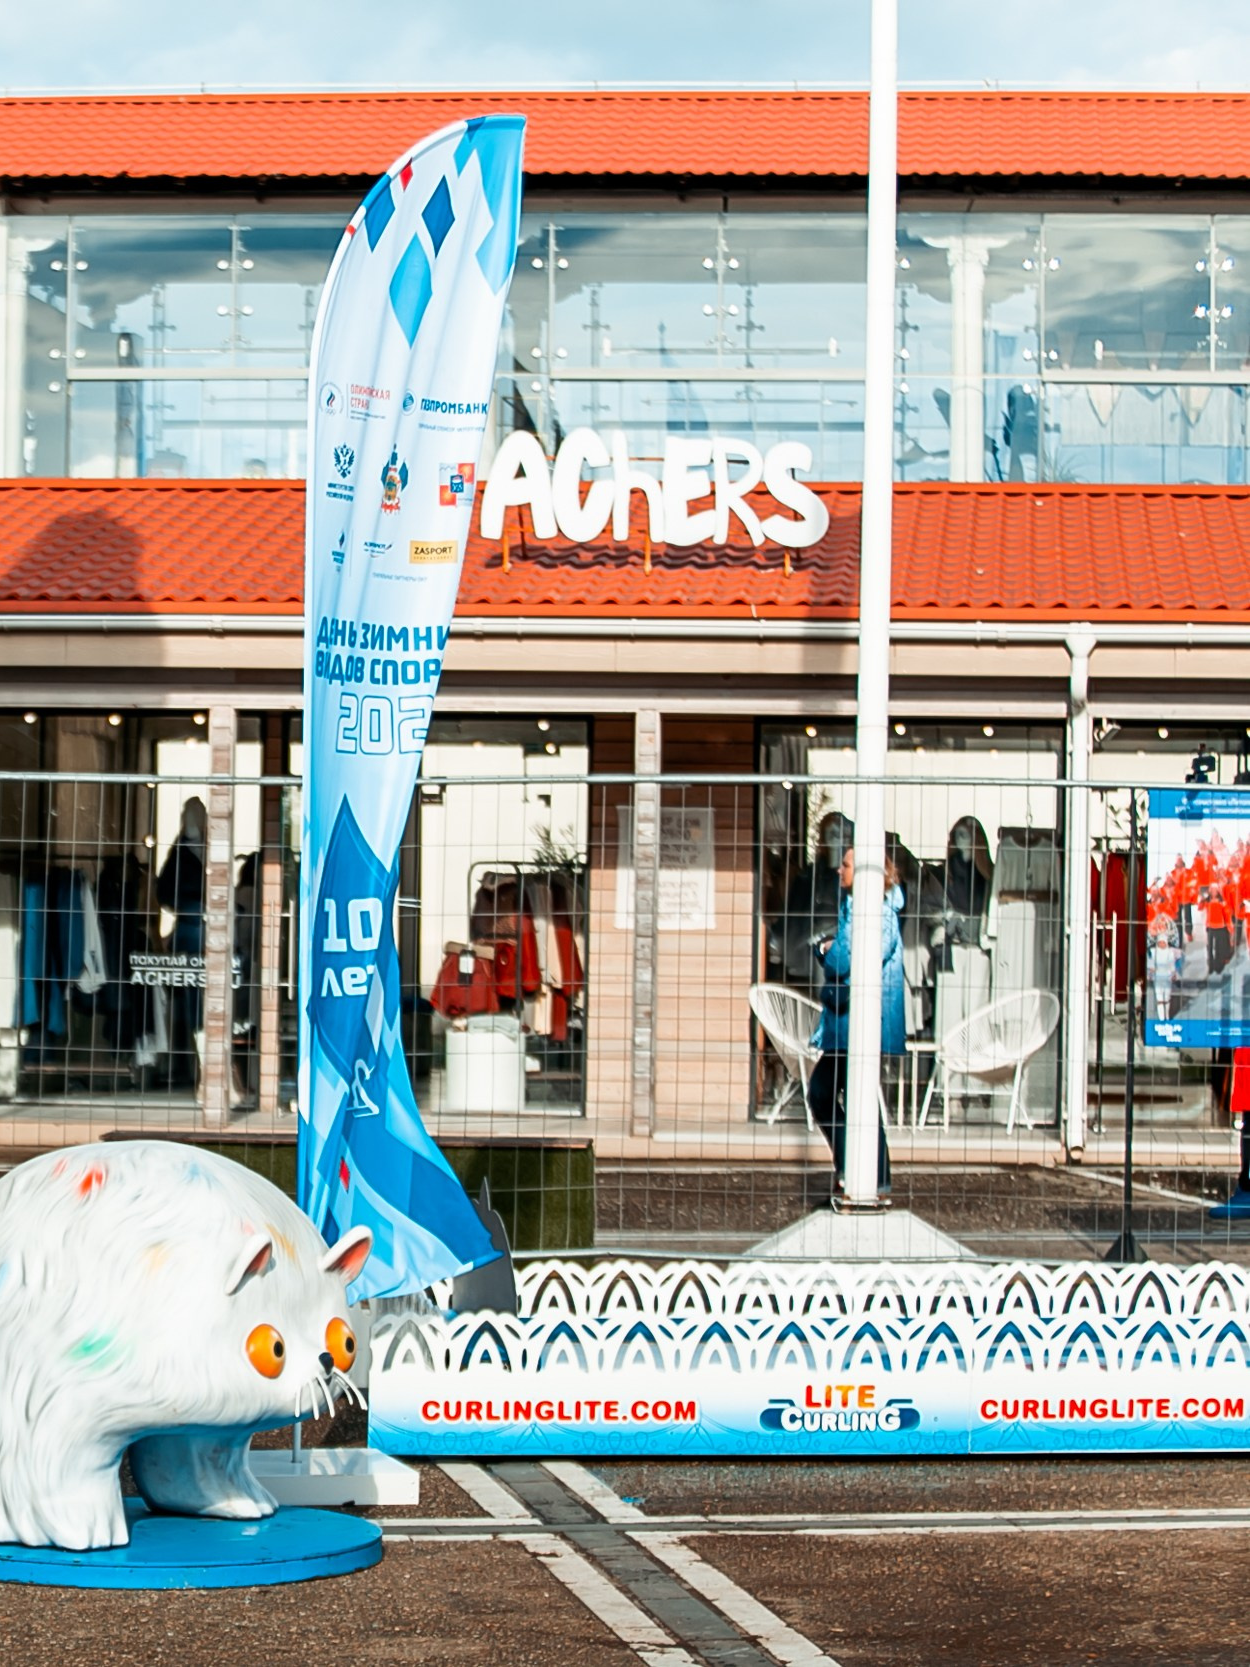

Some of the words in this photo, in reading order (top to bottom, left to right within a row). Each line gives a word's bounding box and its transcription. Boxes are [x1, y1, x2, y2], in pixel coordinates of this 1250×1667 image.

[414, 546, 453, 555] ZASPORT
[315, 650, 365, 686] ВИДОВ
[323, 897, 383, 952] 10
[130, 955, 187, 966] ПОКУПАЙ
[805, 1385, 876, 1408] LITE
[421, 1400, 697, 1421] CURLINGLITE.COM
[781, 1407, 901, 1432] CURLING
[980, 1398, 1245, 1420] CURLINGLITE.COM
